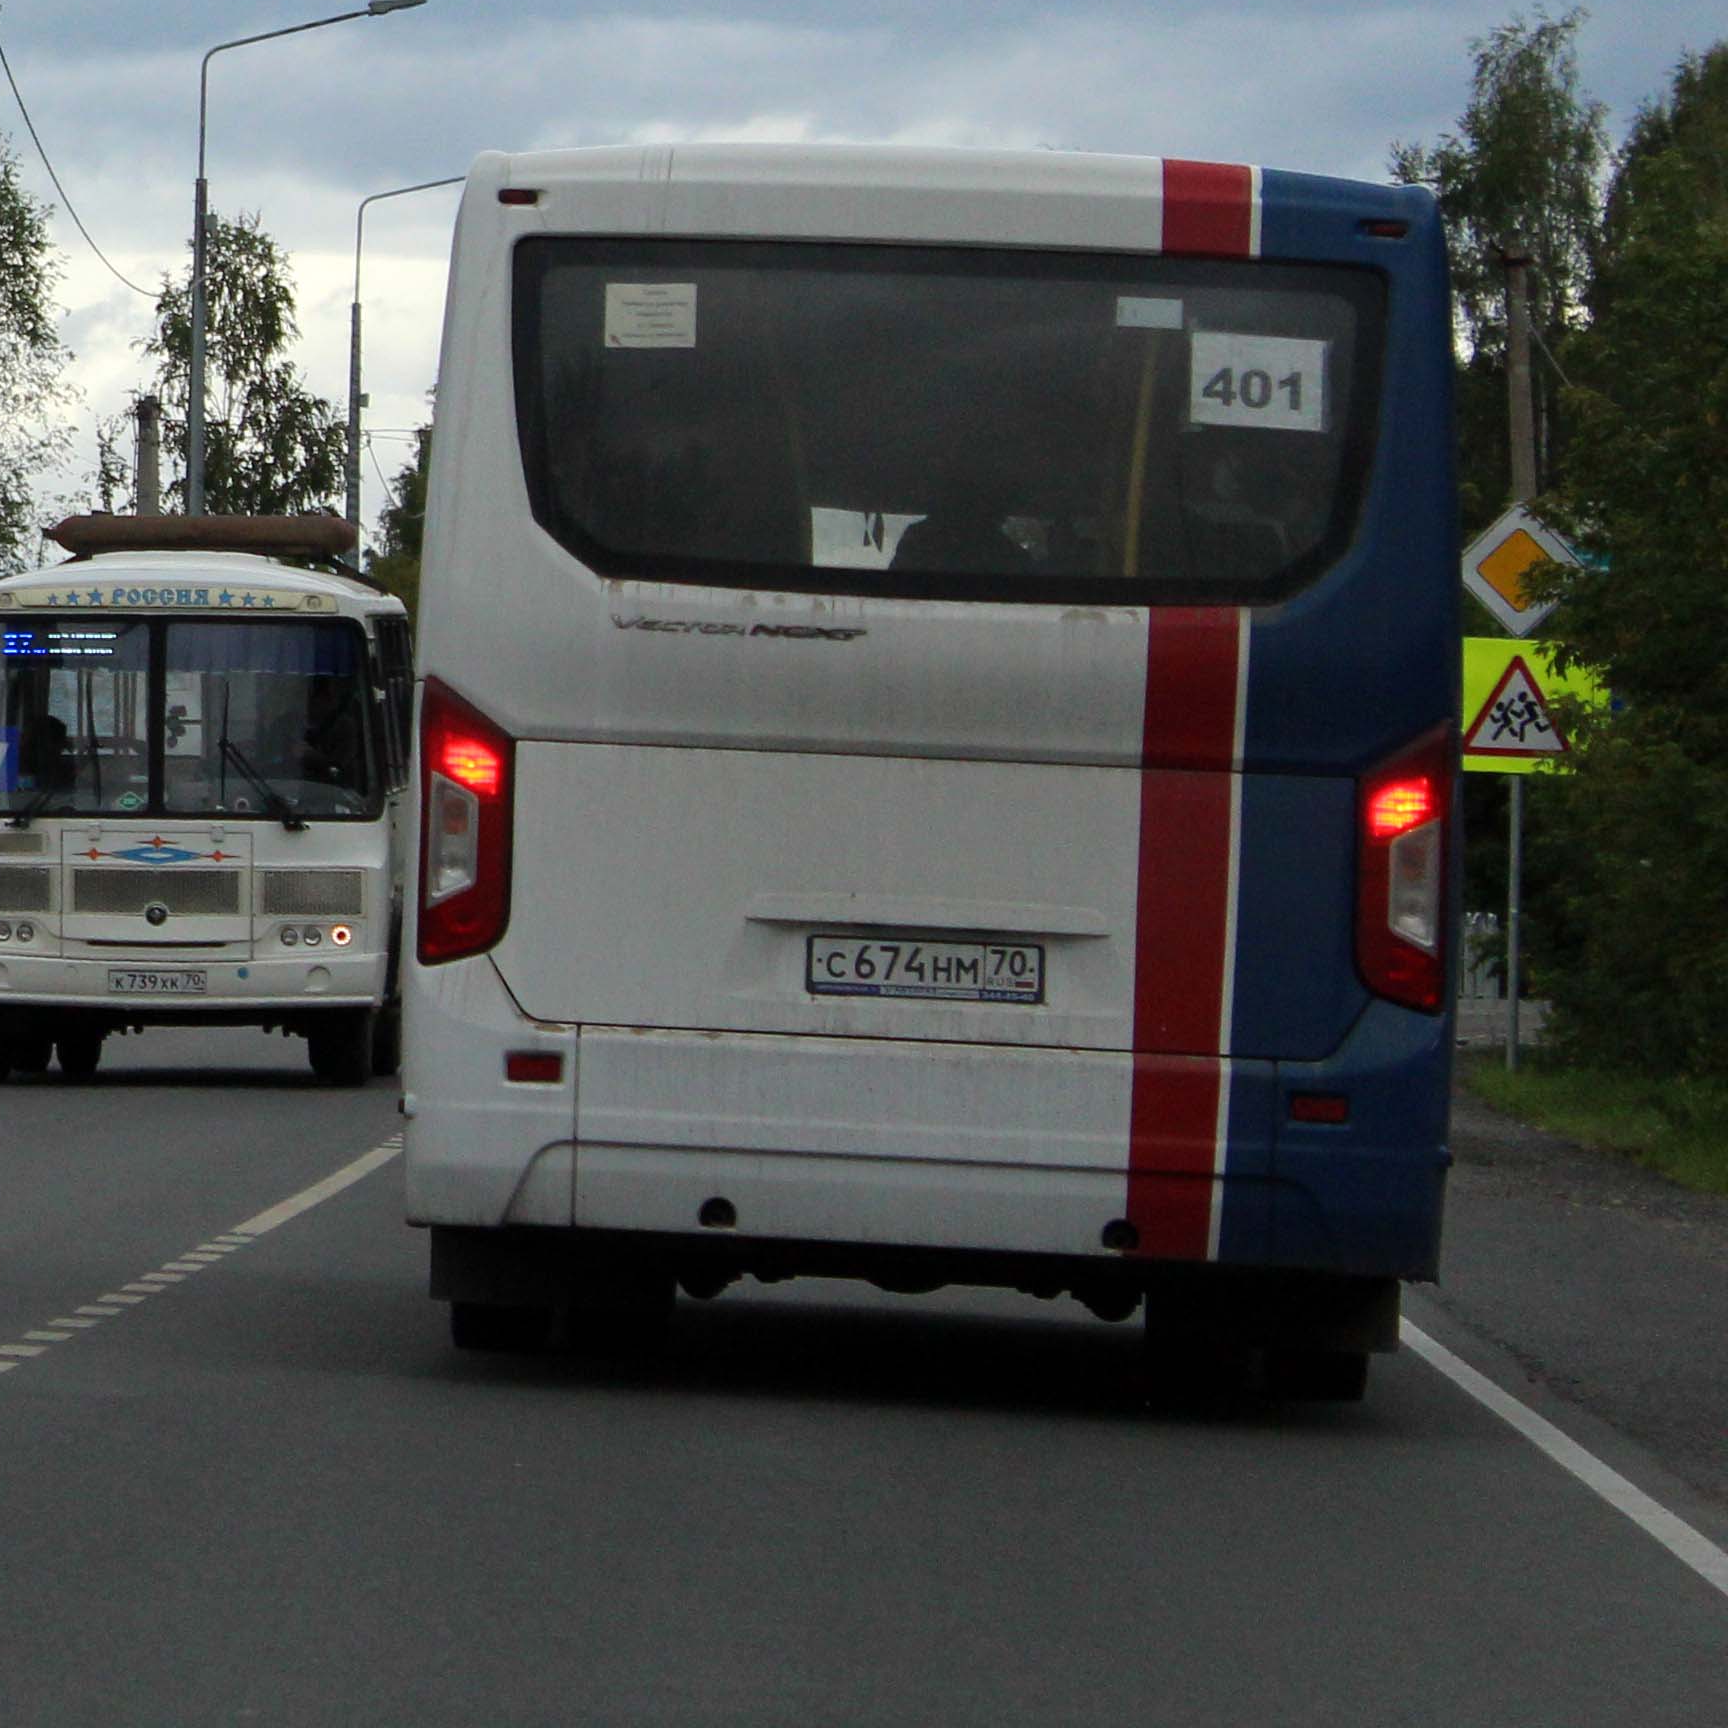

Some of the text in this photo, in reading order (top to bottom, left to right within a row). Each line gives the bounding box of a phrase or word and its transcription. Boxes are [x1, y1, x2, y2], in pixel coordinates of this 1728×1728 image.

[1202, 367, 1302, 410] 401
[111, 588, 209, 606] РОССИЯ
[990, 949, 1026, 976] 70
[186, 974, 200, 985] 70
